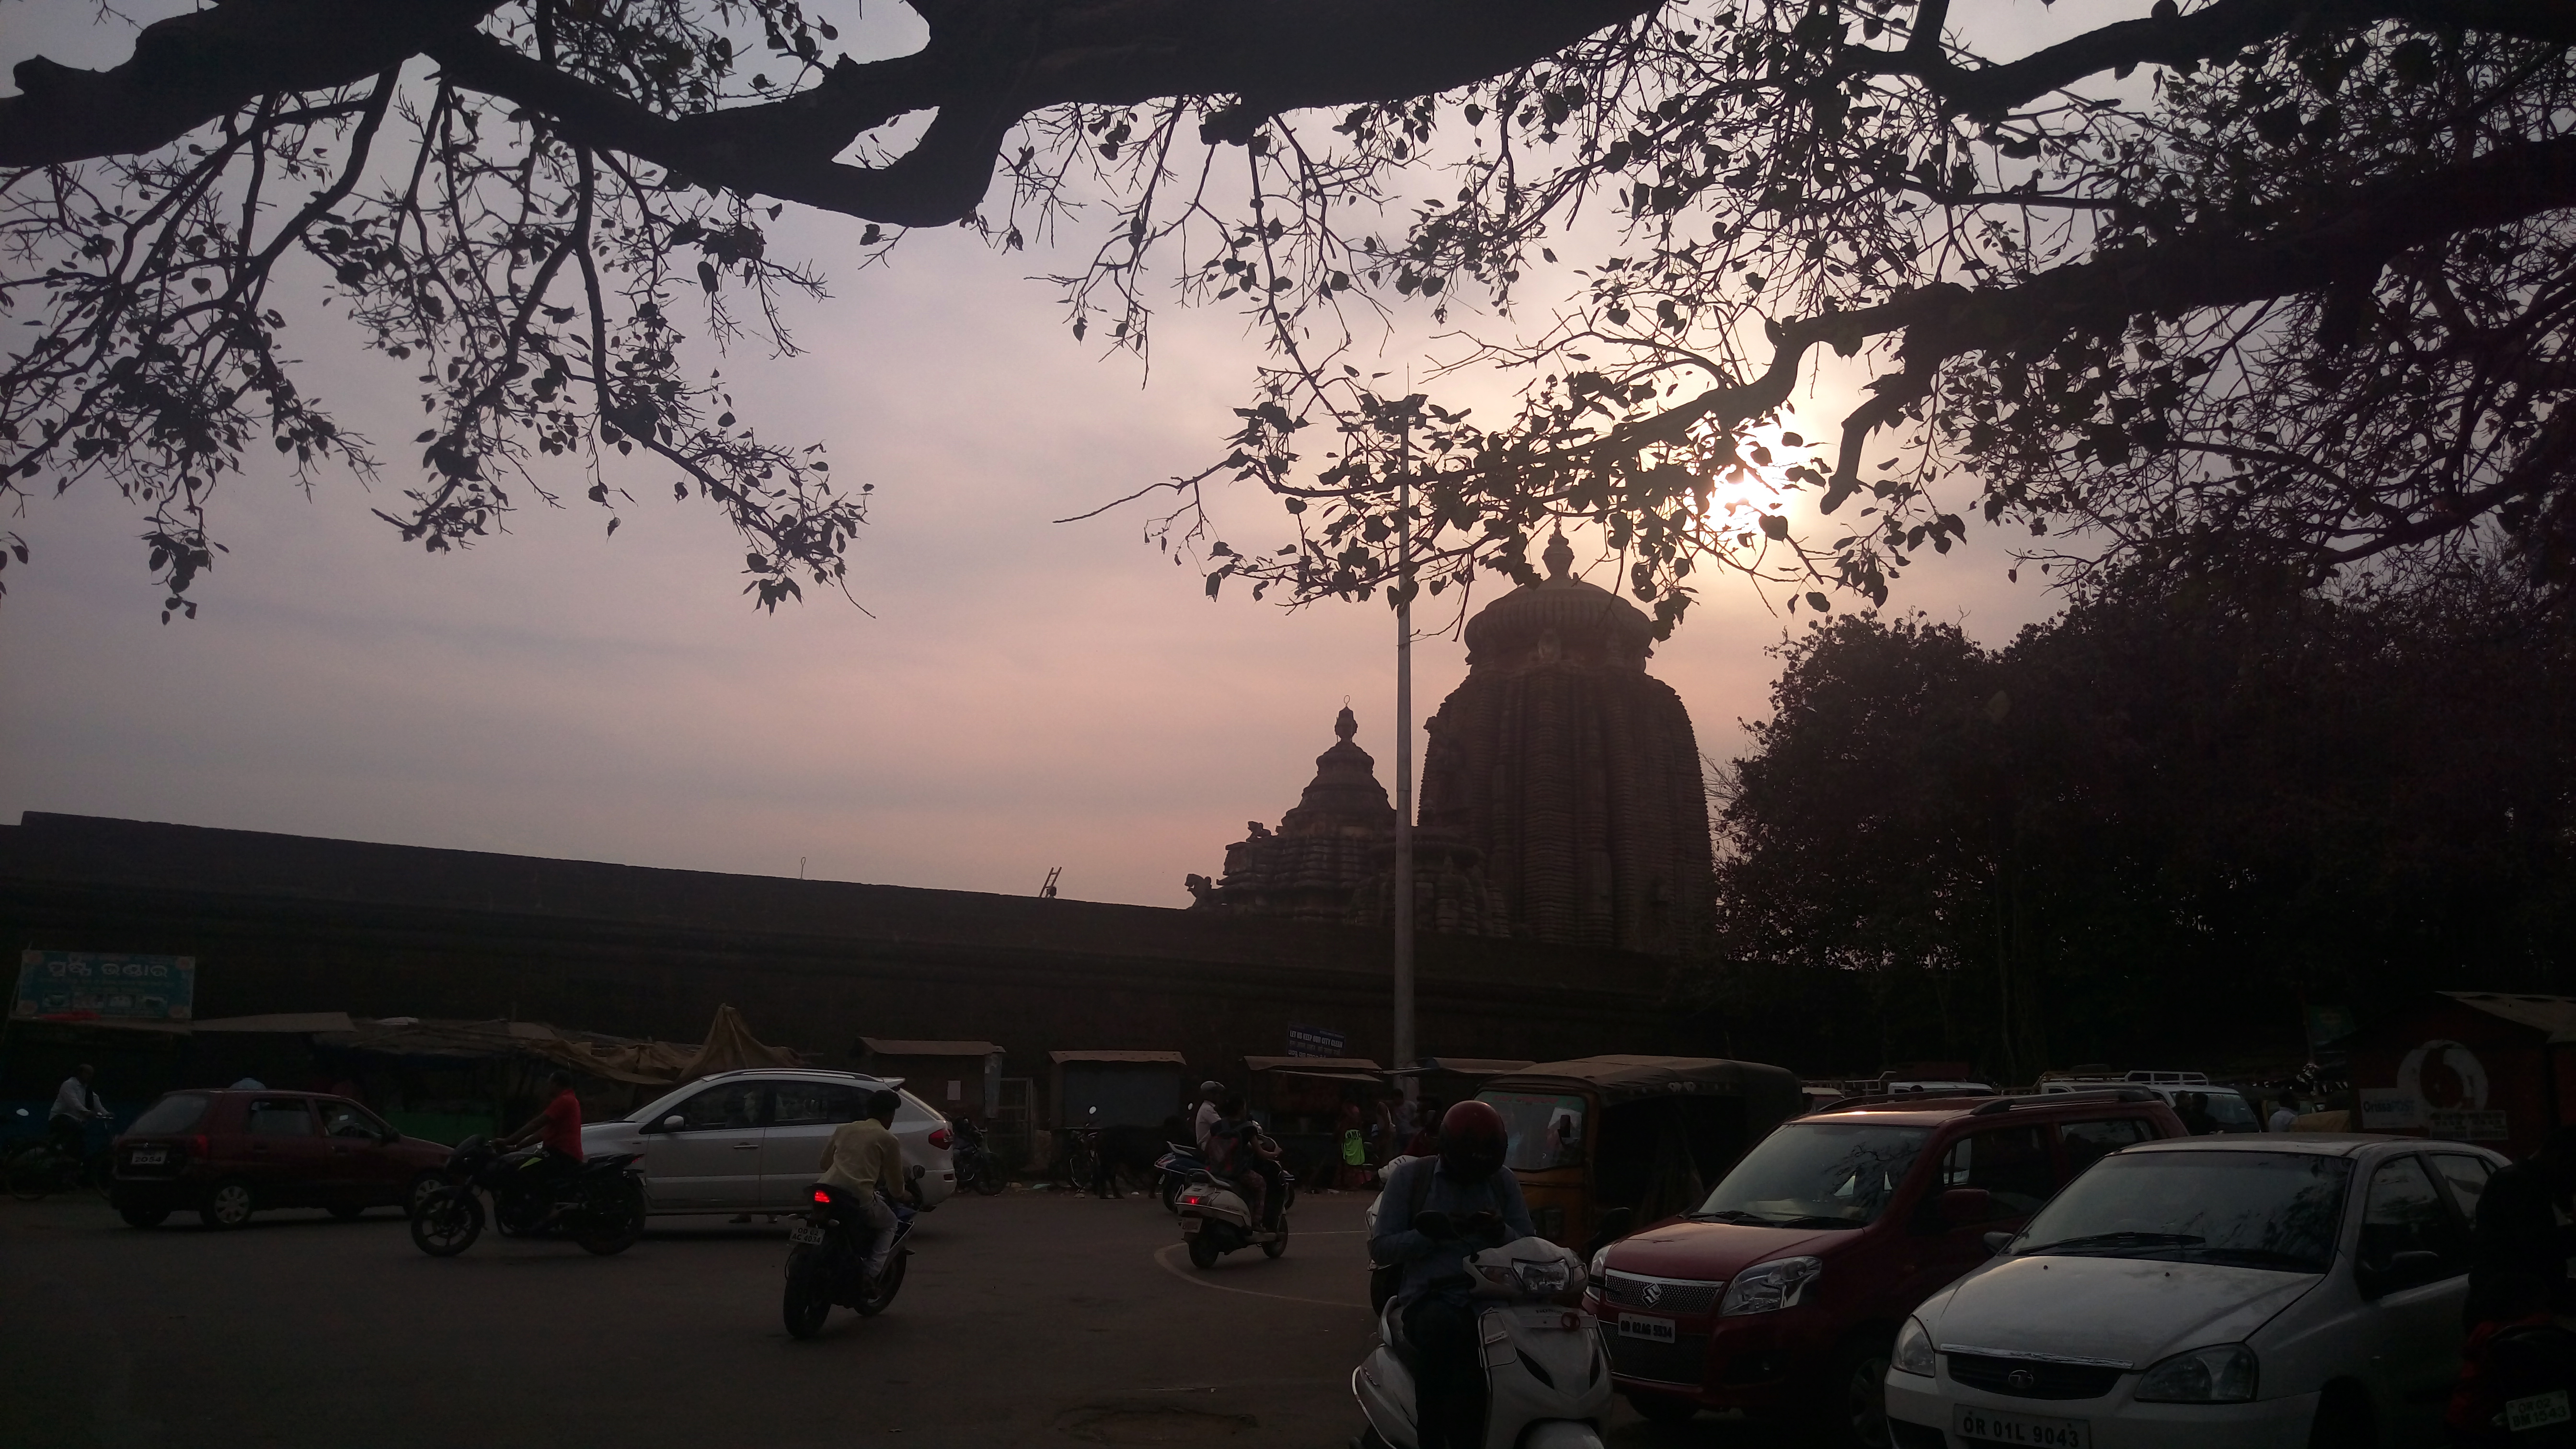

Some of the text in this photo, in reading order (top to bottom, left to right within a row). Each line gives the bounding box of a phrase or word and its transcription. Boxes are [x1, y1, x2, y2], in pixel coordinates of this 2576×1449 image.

[1303, 1033, 1312, 1041] KEEP
[1322, 1037, 1331, 1046] CITY
[1331, 1039, 1343, 1048] CLEAN
[2518, 1398, 2551, 1413] OR 02
[2512, 1405, 2566, 1427] BM 1543
[1964, 1416, 2079, 1448] OR 01L 9043
